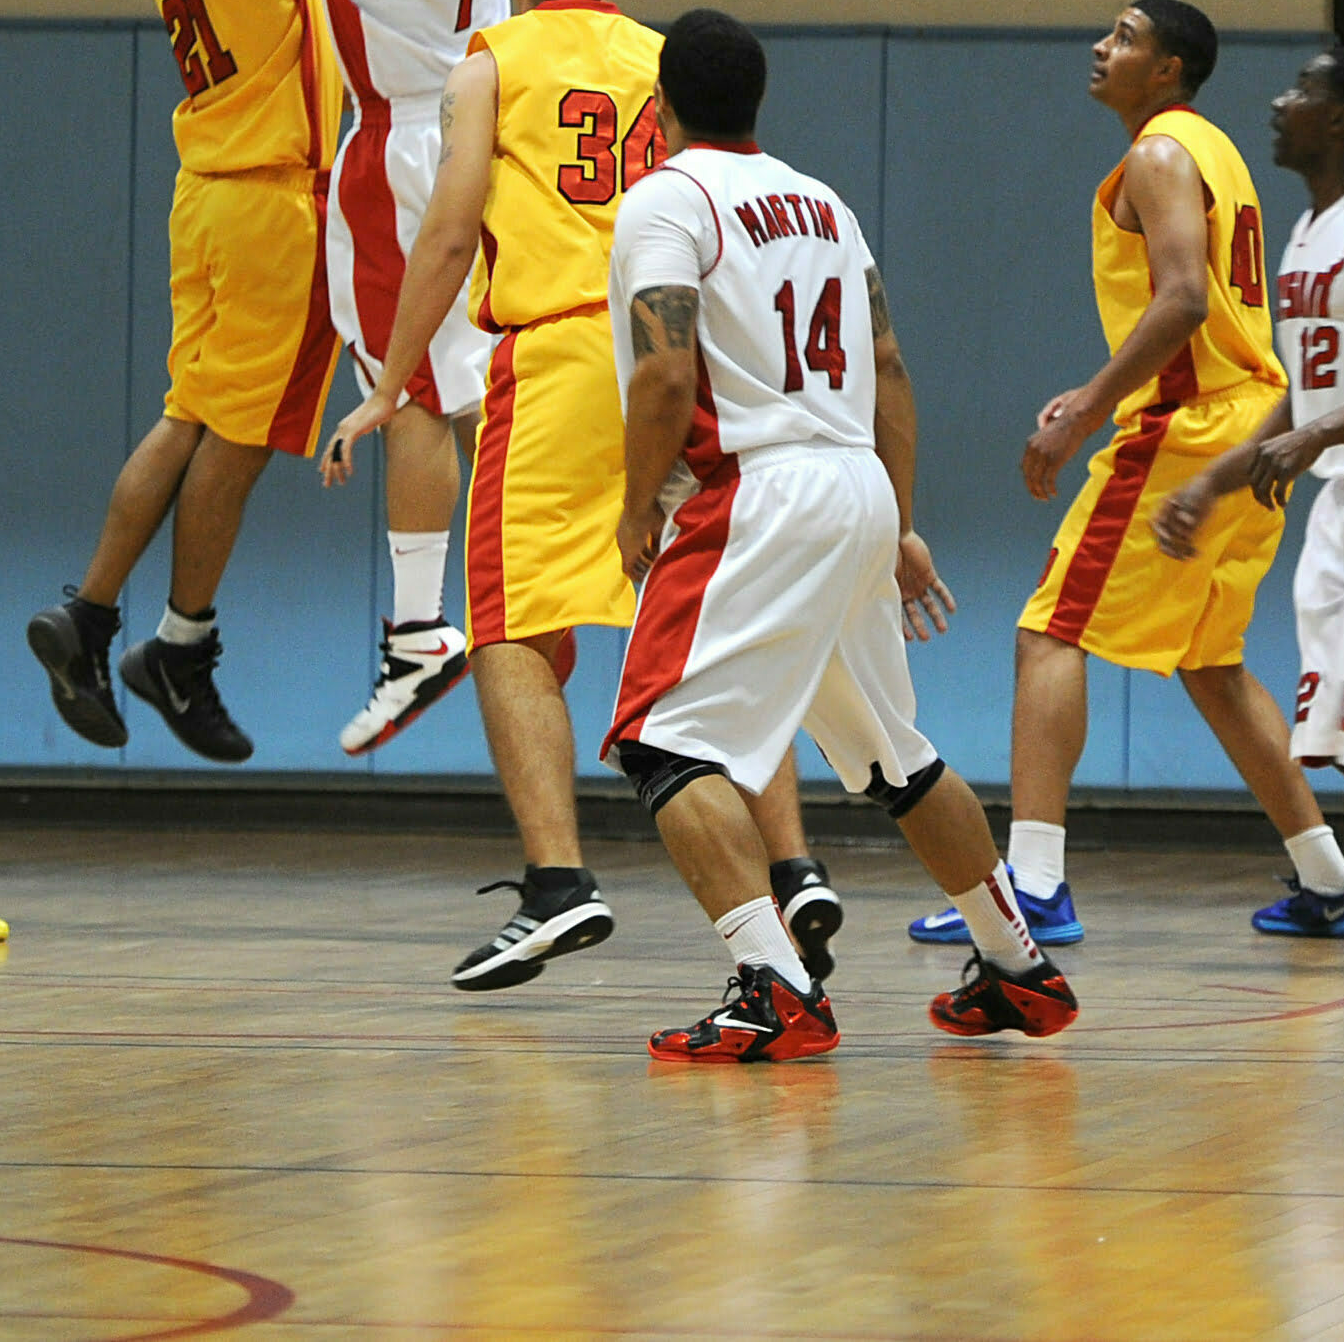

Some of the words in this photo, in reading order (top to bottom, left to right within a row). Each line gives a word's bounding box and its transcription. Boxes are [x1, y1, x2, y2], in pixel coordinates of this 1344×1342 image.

[734, 192, 840, 249] MARTIN
[774, 276, 847, 394] 14
[1300, 325, 1341, 391] 12
